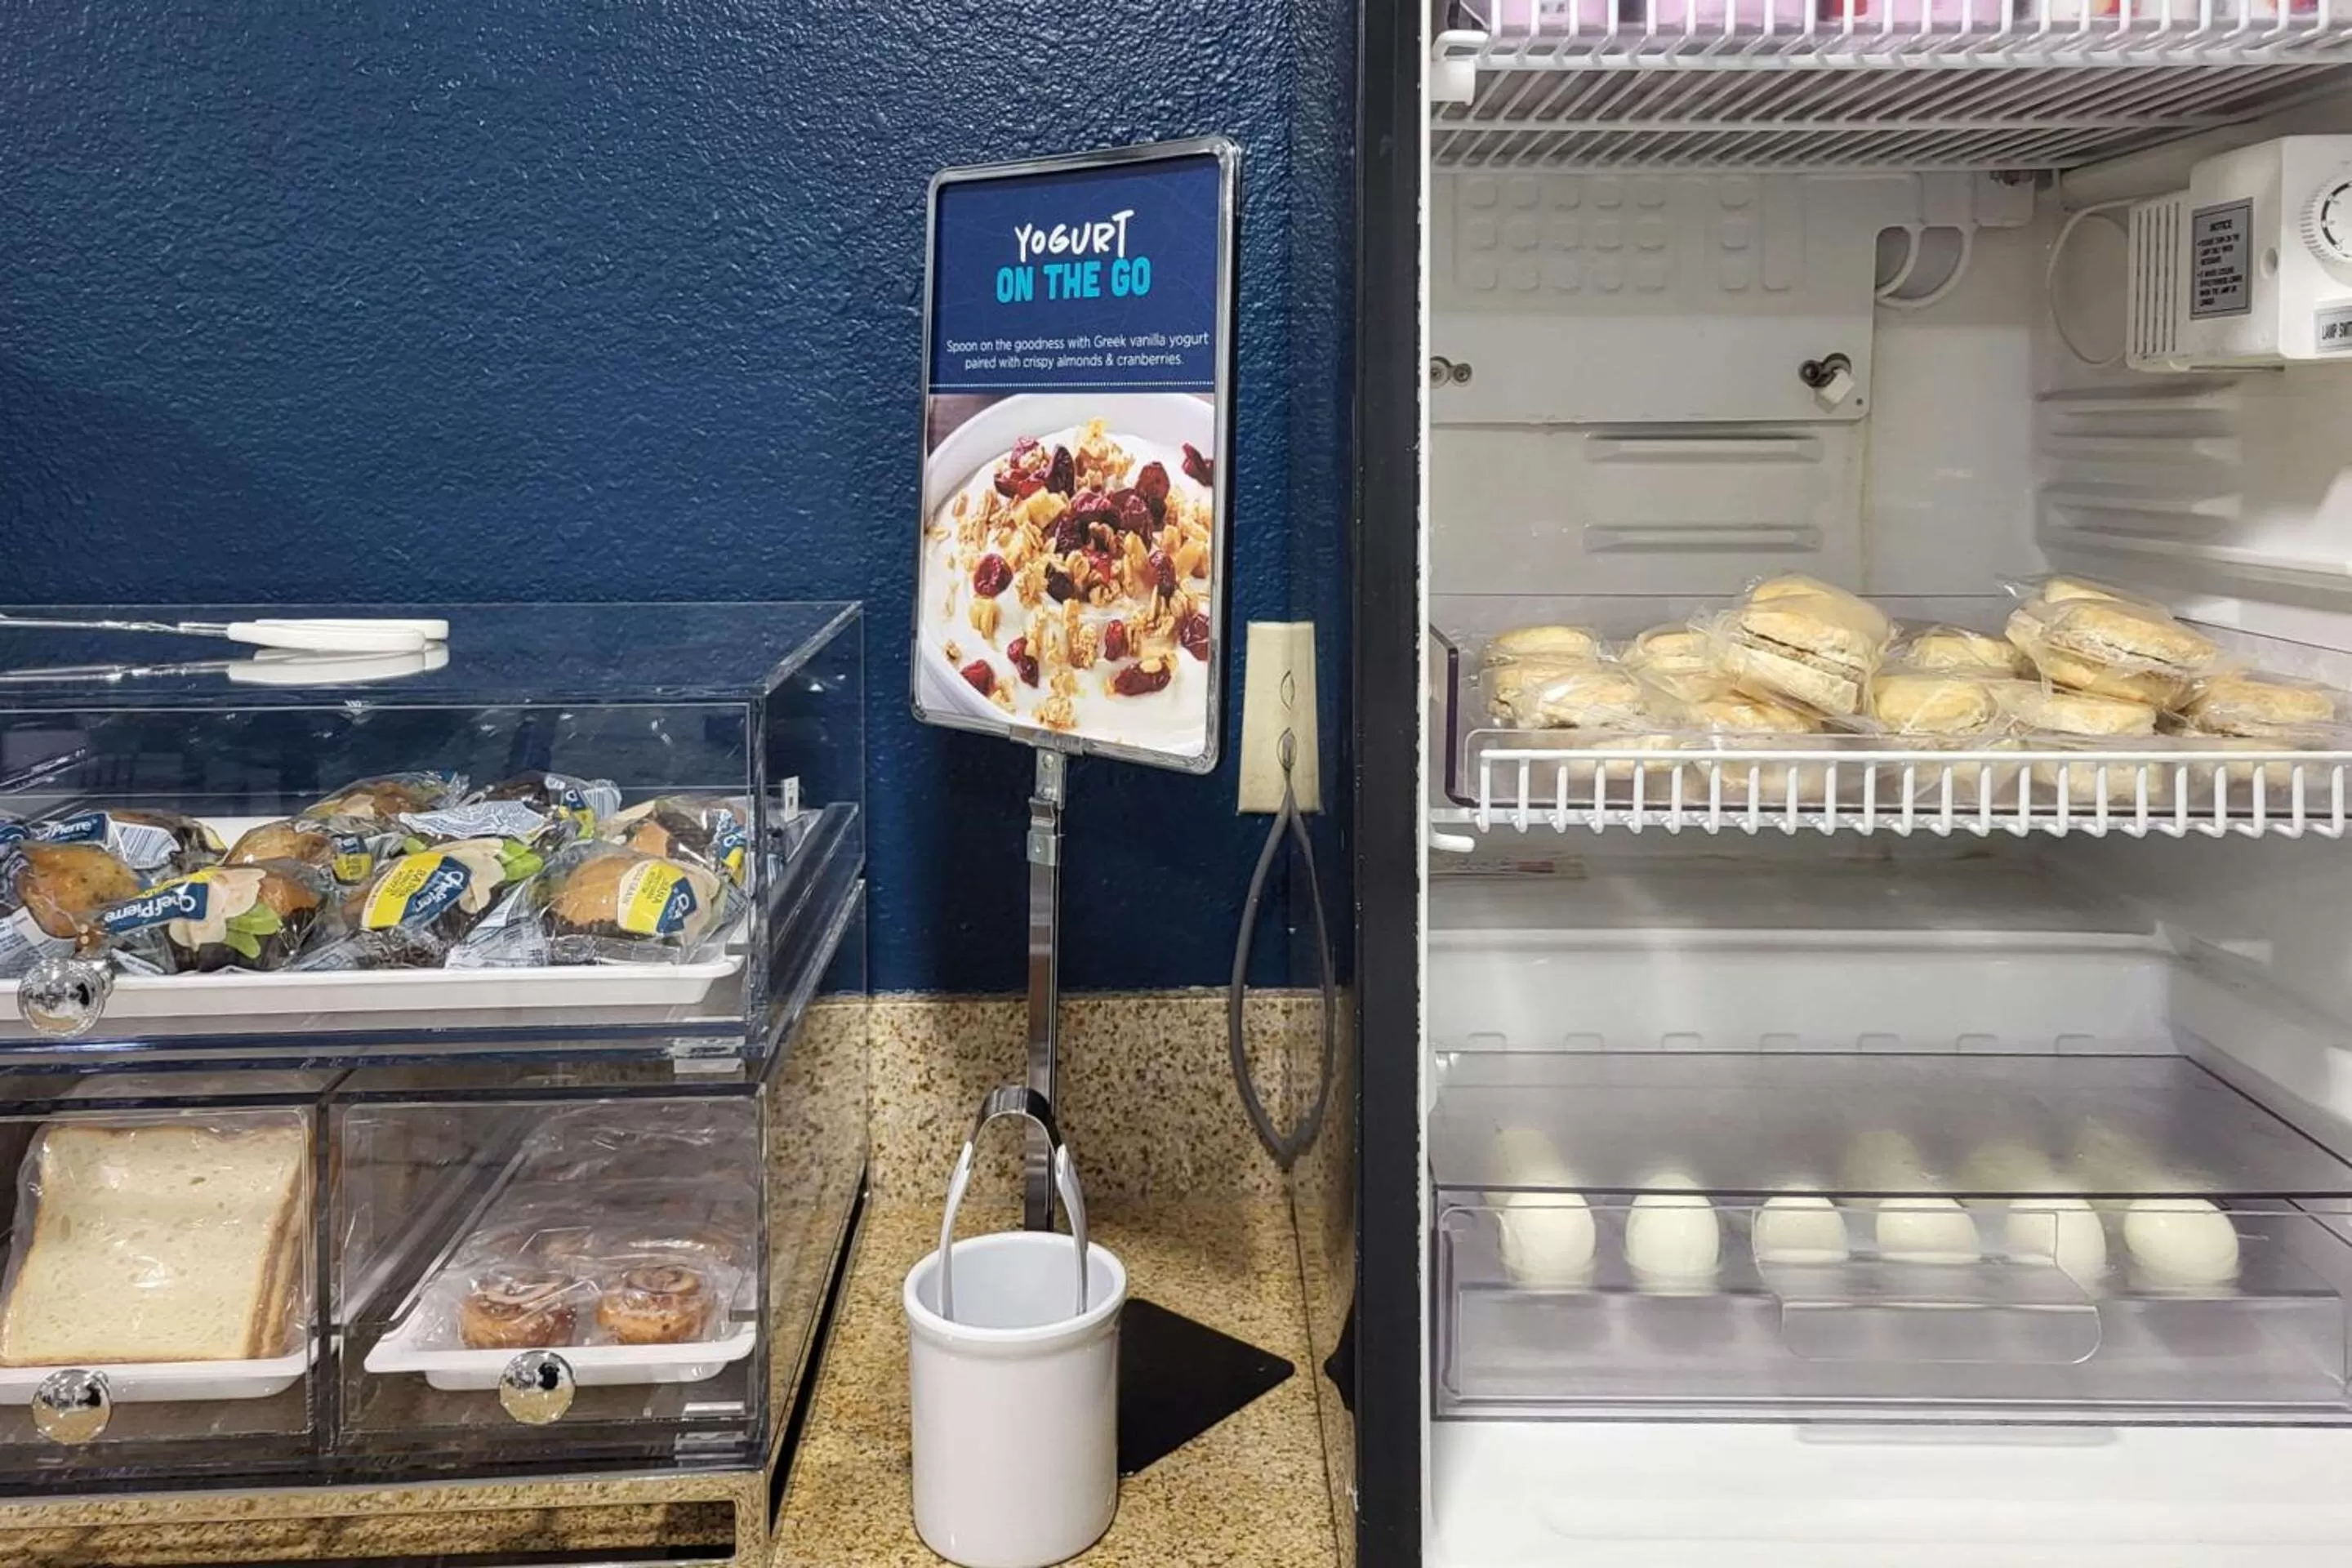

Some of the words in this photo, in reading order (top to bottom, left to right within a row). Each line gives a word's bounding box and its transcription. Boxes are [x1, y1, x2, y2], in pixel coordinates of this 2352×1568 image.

[1014, 210, 1134, 262] YOGURT
[996, 266, 1034, 303] ON
[1044, 261, 1101, 300] THE
[1111, 256, 1152, 296] GO
[947, 339, 978, 354] Spoon
[981, 341, 993, 351] on
[996, 338, 1013, 350] the
[1014, 337, 1065, 353] goodness
[1067, 336, 1092, 349] with
[1094, 335, 1126, 349] Greek
[1129, 333, 1166, 347] vanilla
[1169, 332, 1209, 349] yogurt
[964, 356, 996, 371] paired
[999, 356, 1021, 369] with
[1022, 356, 1054, 369] crispy
[1058, 353, 1103, 367] almonds
[1105, 353, 1114, 367] &
[1116, 353, 1185, 367] cranberries.
[104, 899, 154, 923] Pierre
